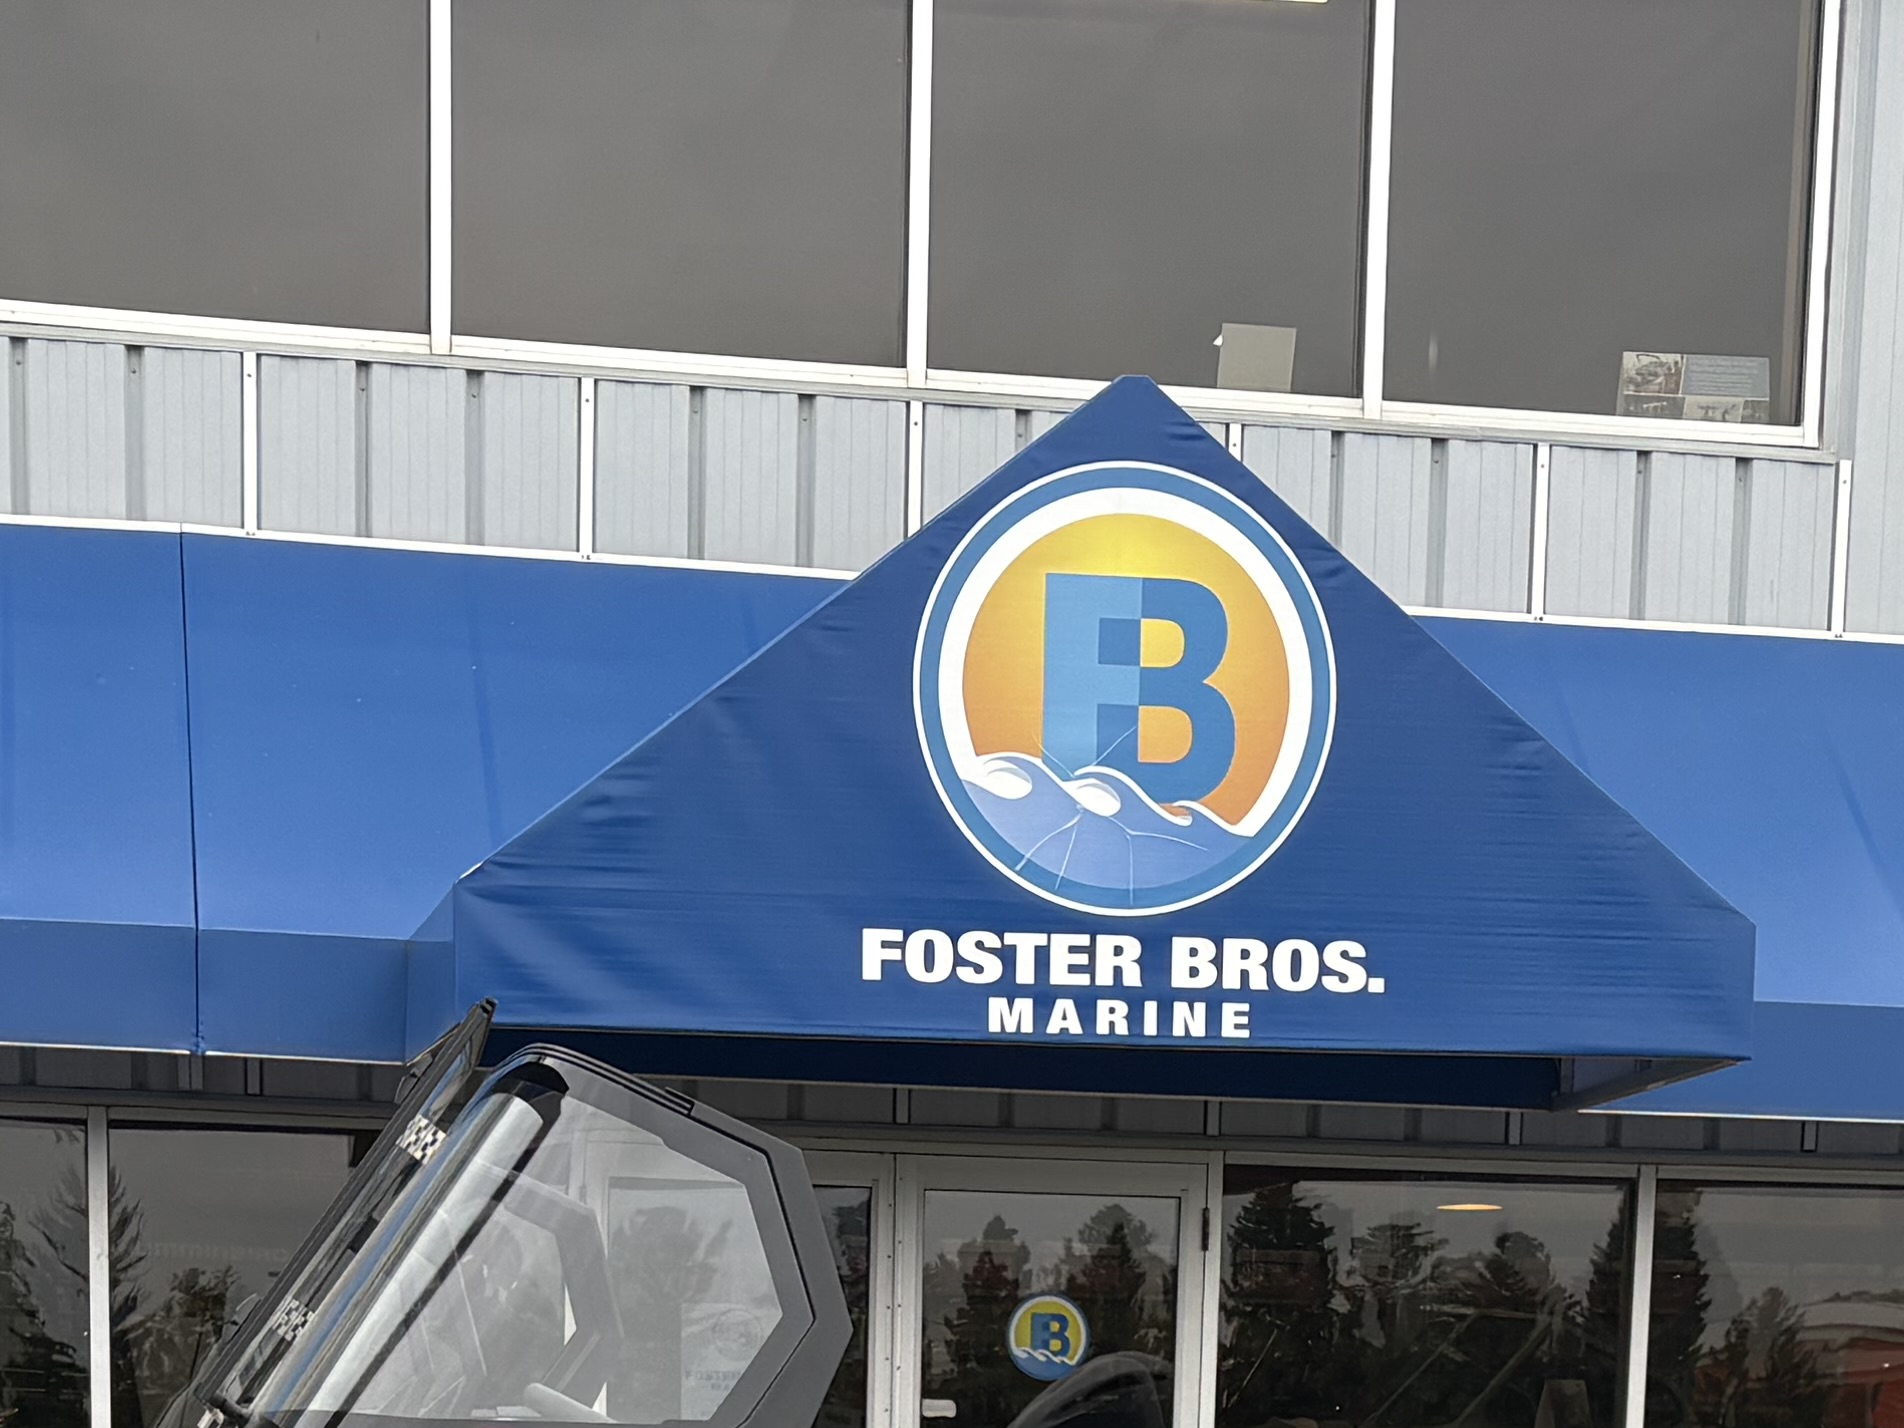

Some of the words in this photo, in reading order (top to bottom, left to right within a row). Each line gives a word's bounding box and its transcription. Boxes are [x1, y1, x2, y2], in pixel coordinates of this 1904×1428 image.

[861, 926, 1142, 988] FOSTER
[1169, 932, 1387, 994] BROS.
[986, 994, 1253, 1039] MARINE
